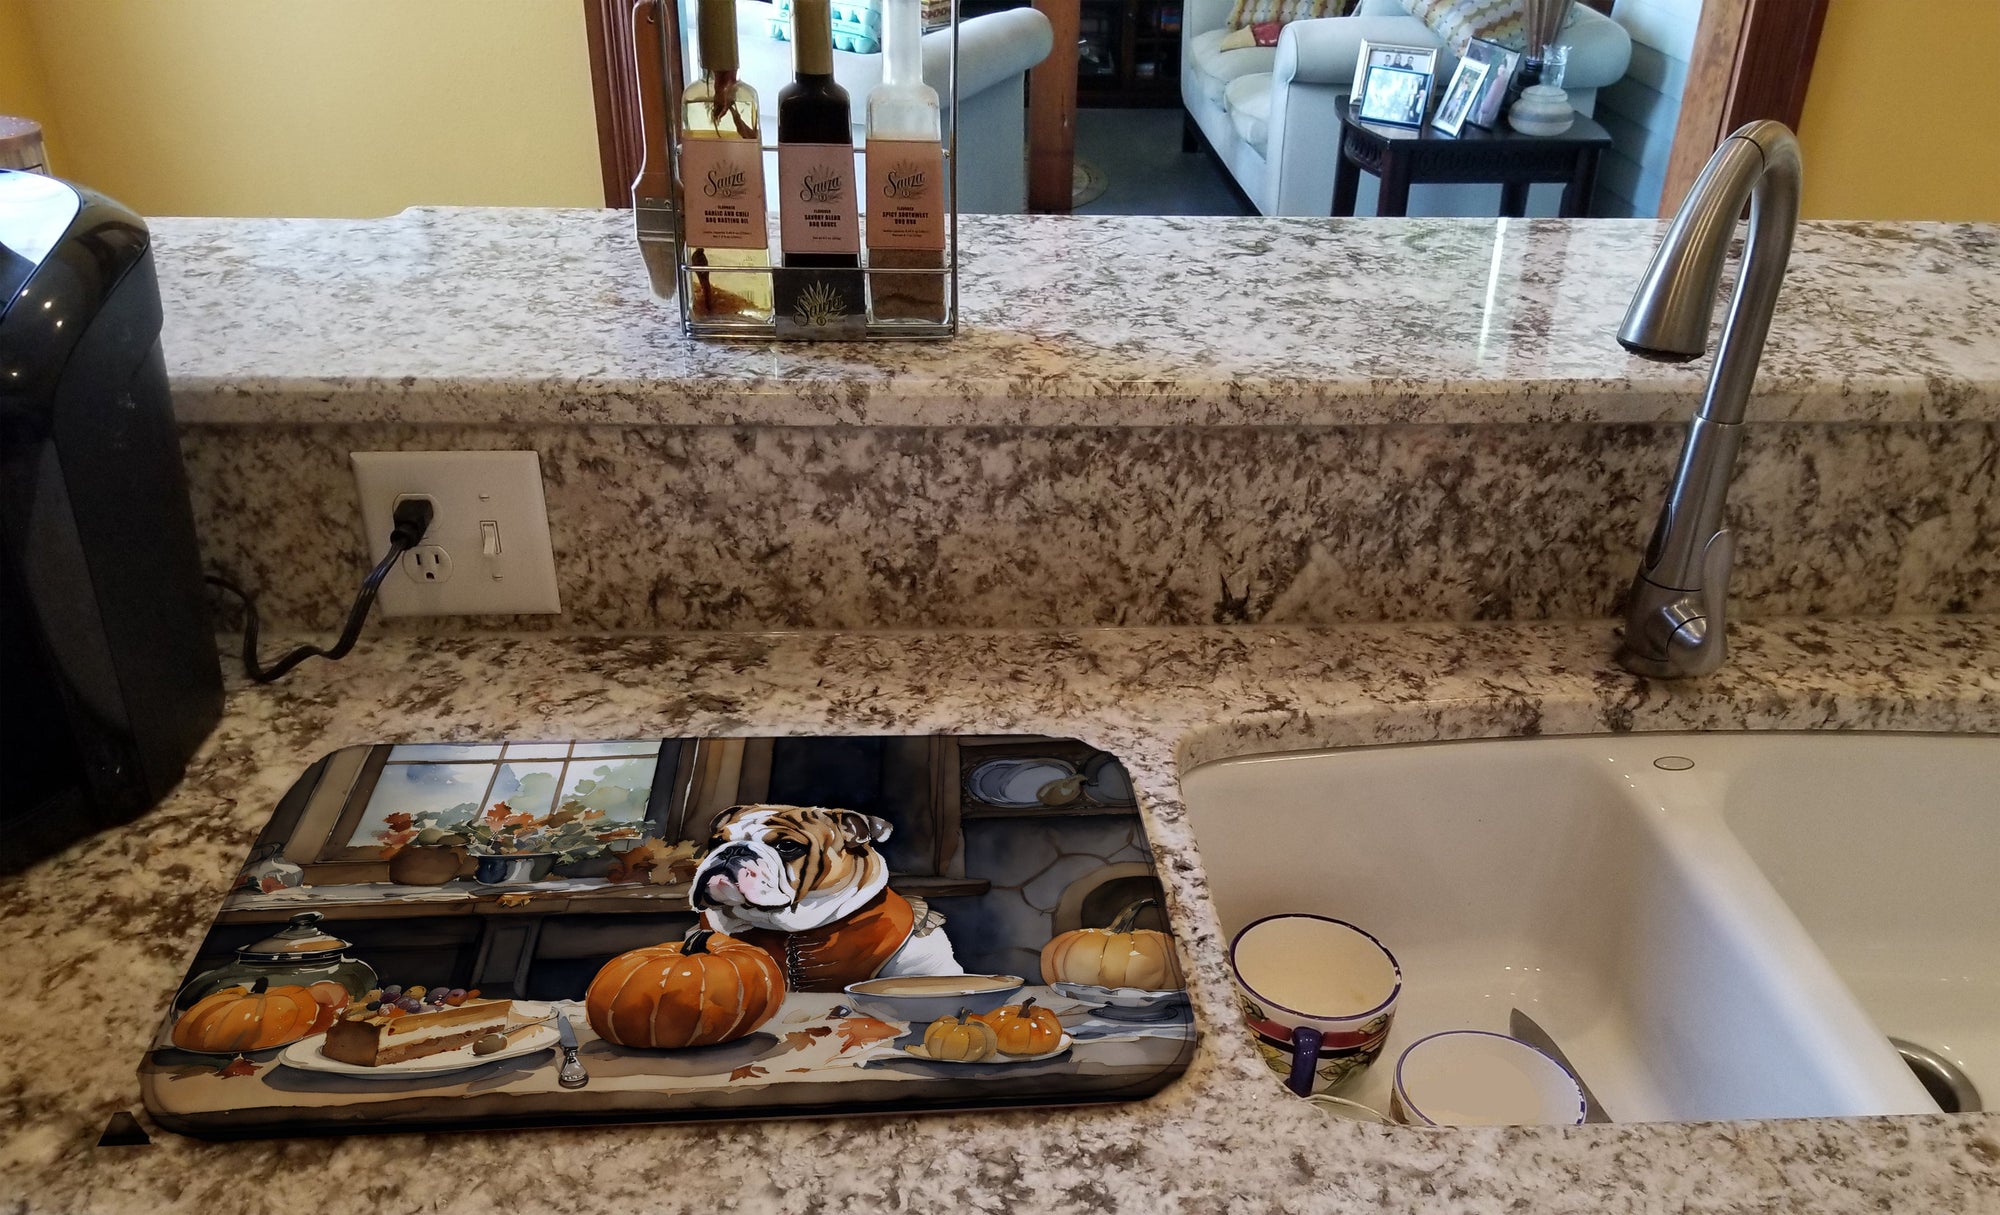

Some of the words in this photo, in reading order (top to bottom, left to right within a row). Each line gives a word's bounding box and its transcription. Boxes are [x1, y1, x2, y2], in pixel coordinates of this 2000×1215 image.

[704, 170, 745, 197] Sauza
[800, 175, 842, 202] Sauza
[883, 171, 925, 198] Sauza
[793, 294, 844, 327] Sauza
